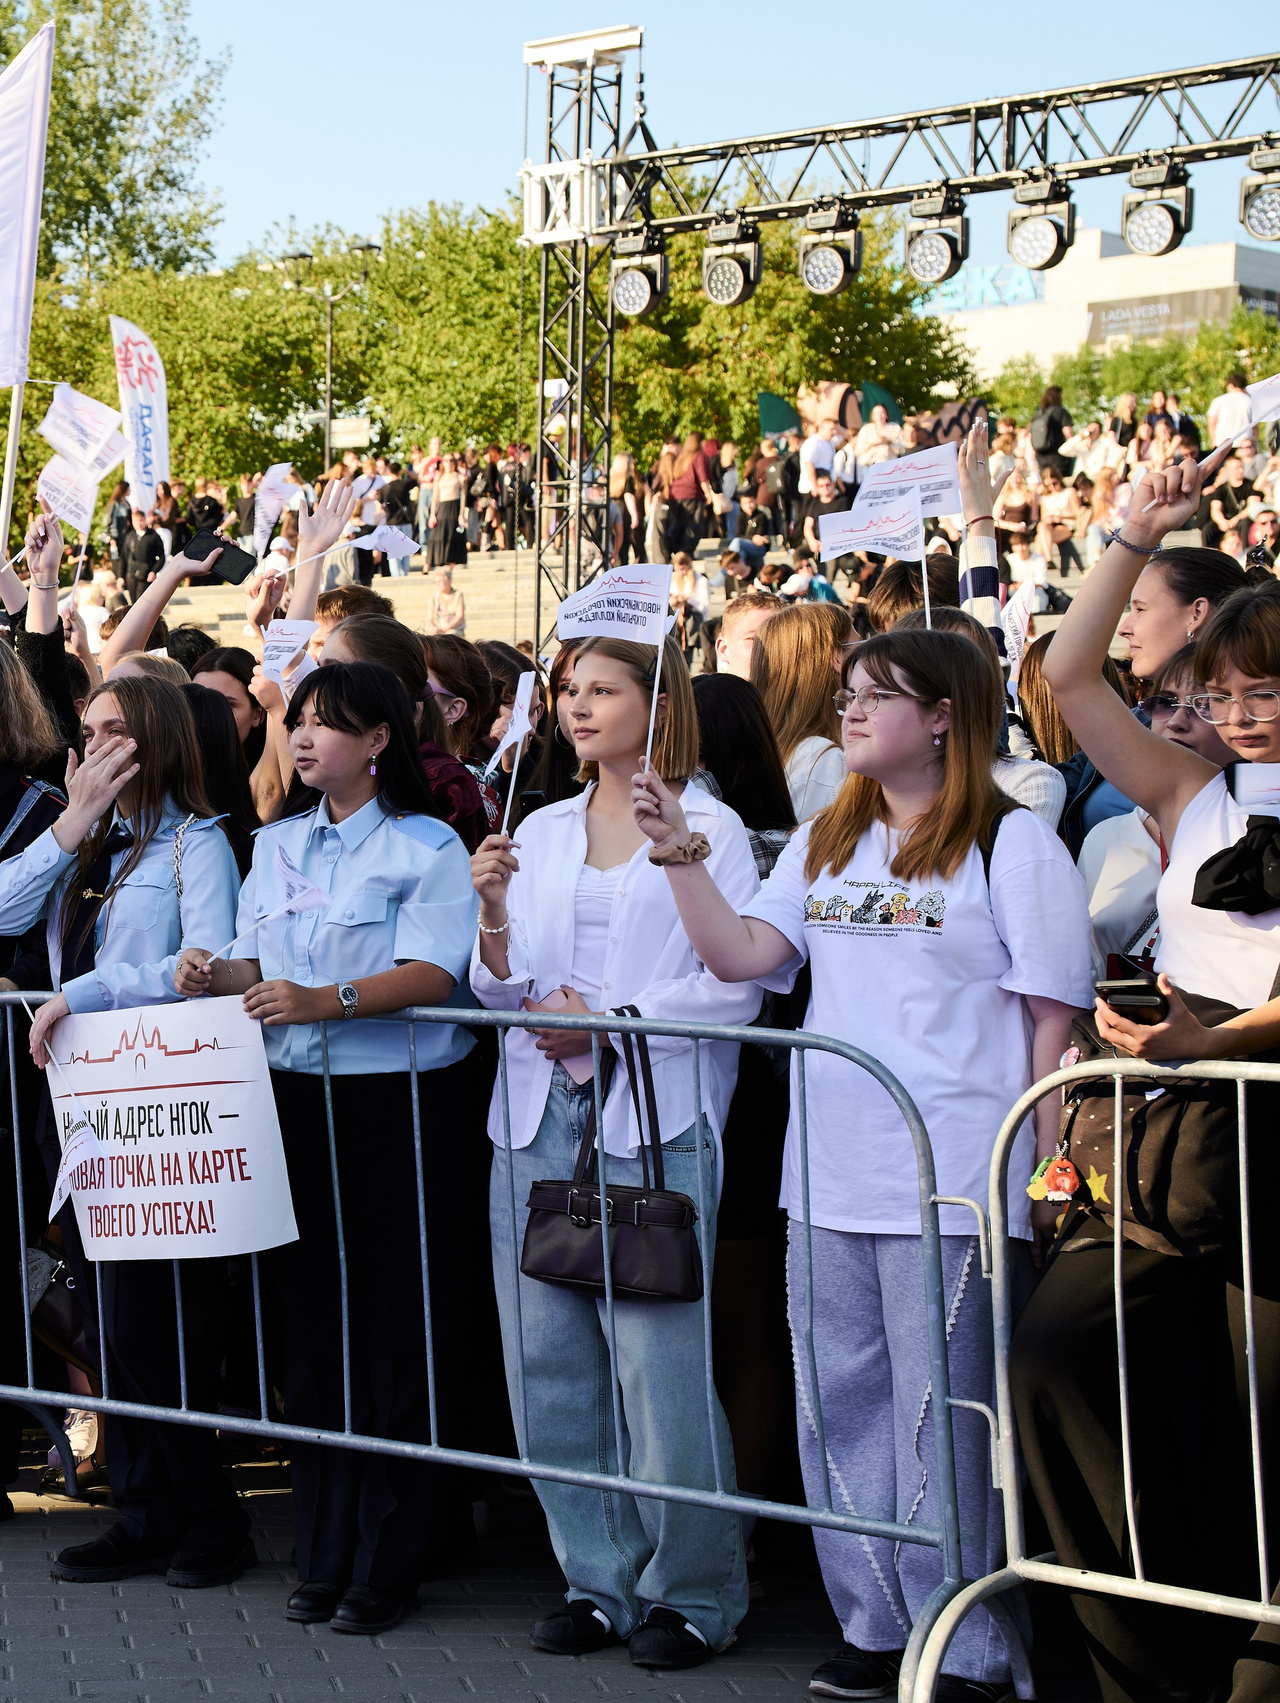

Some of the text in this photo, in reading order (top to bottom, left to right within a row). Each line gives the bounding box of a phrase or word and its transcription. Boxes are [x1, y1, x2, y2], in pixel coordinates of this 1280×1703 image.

[1101, 303, 1171, 322] LADA VESTA
[63, 1101, 109, 1141] НЫЙ
[113, 1103, 165, 1146] АДРЕС
[170, 1101, 213, 1136] НГОК
[109, 1153, 156, 1189] ТОЧКА
[160, 1151, 184, 1186] НА
[188, 1148, 252, 1185] КАРТЕ
[87, 1199, 217, 1238] ТВОЕГО УСПЕХА!
